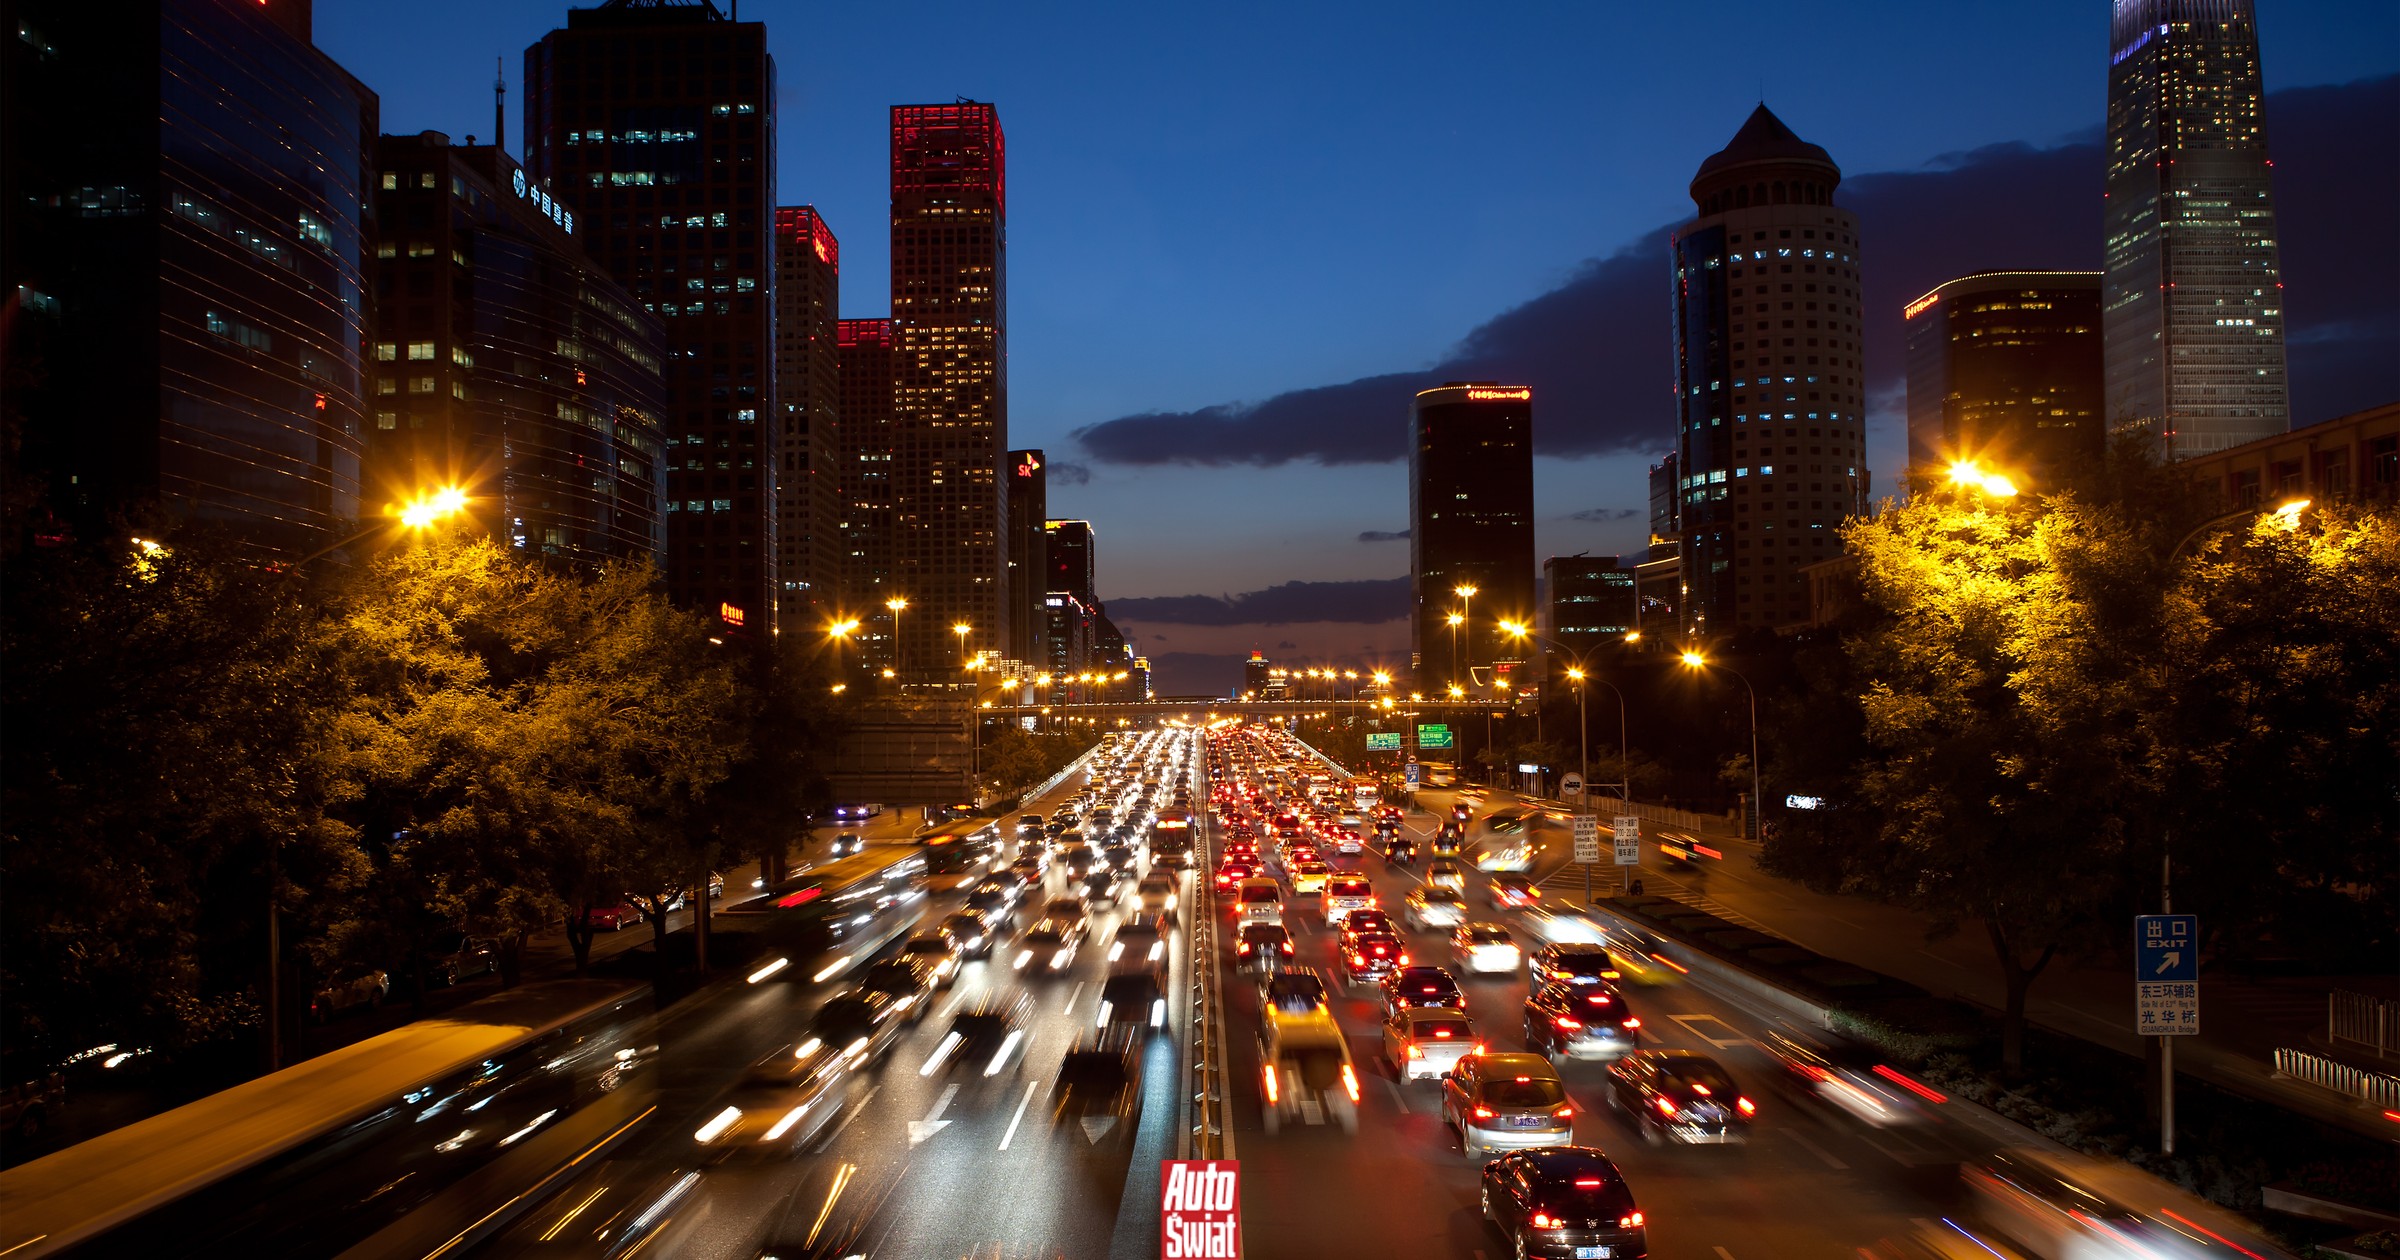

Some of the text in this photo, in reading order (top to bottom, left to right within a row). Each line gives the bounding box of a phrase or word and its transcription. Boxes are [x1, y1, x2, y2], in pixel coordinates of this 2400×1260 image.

[530, 184, 573, 235] 中国惠普
[1018, 464, 1032, 477] SK
[2147, 920, 2187, 938] 出口
[2146, 939, 2188, 948] EXIT
[2142, 985, 2195, 998] 东三环辅路
[2141, 1000, 2151, 1008] Side
[2152, 1000, 2158, 1008] Rd
[2160, 1000, 2164, 1008] of
[2179, 1000, 2188, 1009] Ring
[2190, 1000, 2196, 1008] Rd
[2142, 1010, 2195, 1024] 光华桥
[2141, 1025, 2196, 1034] GUANGHUA Bridge
